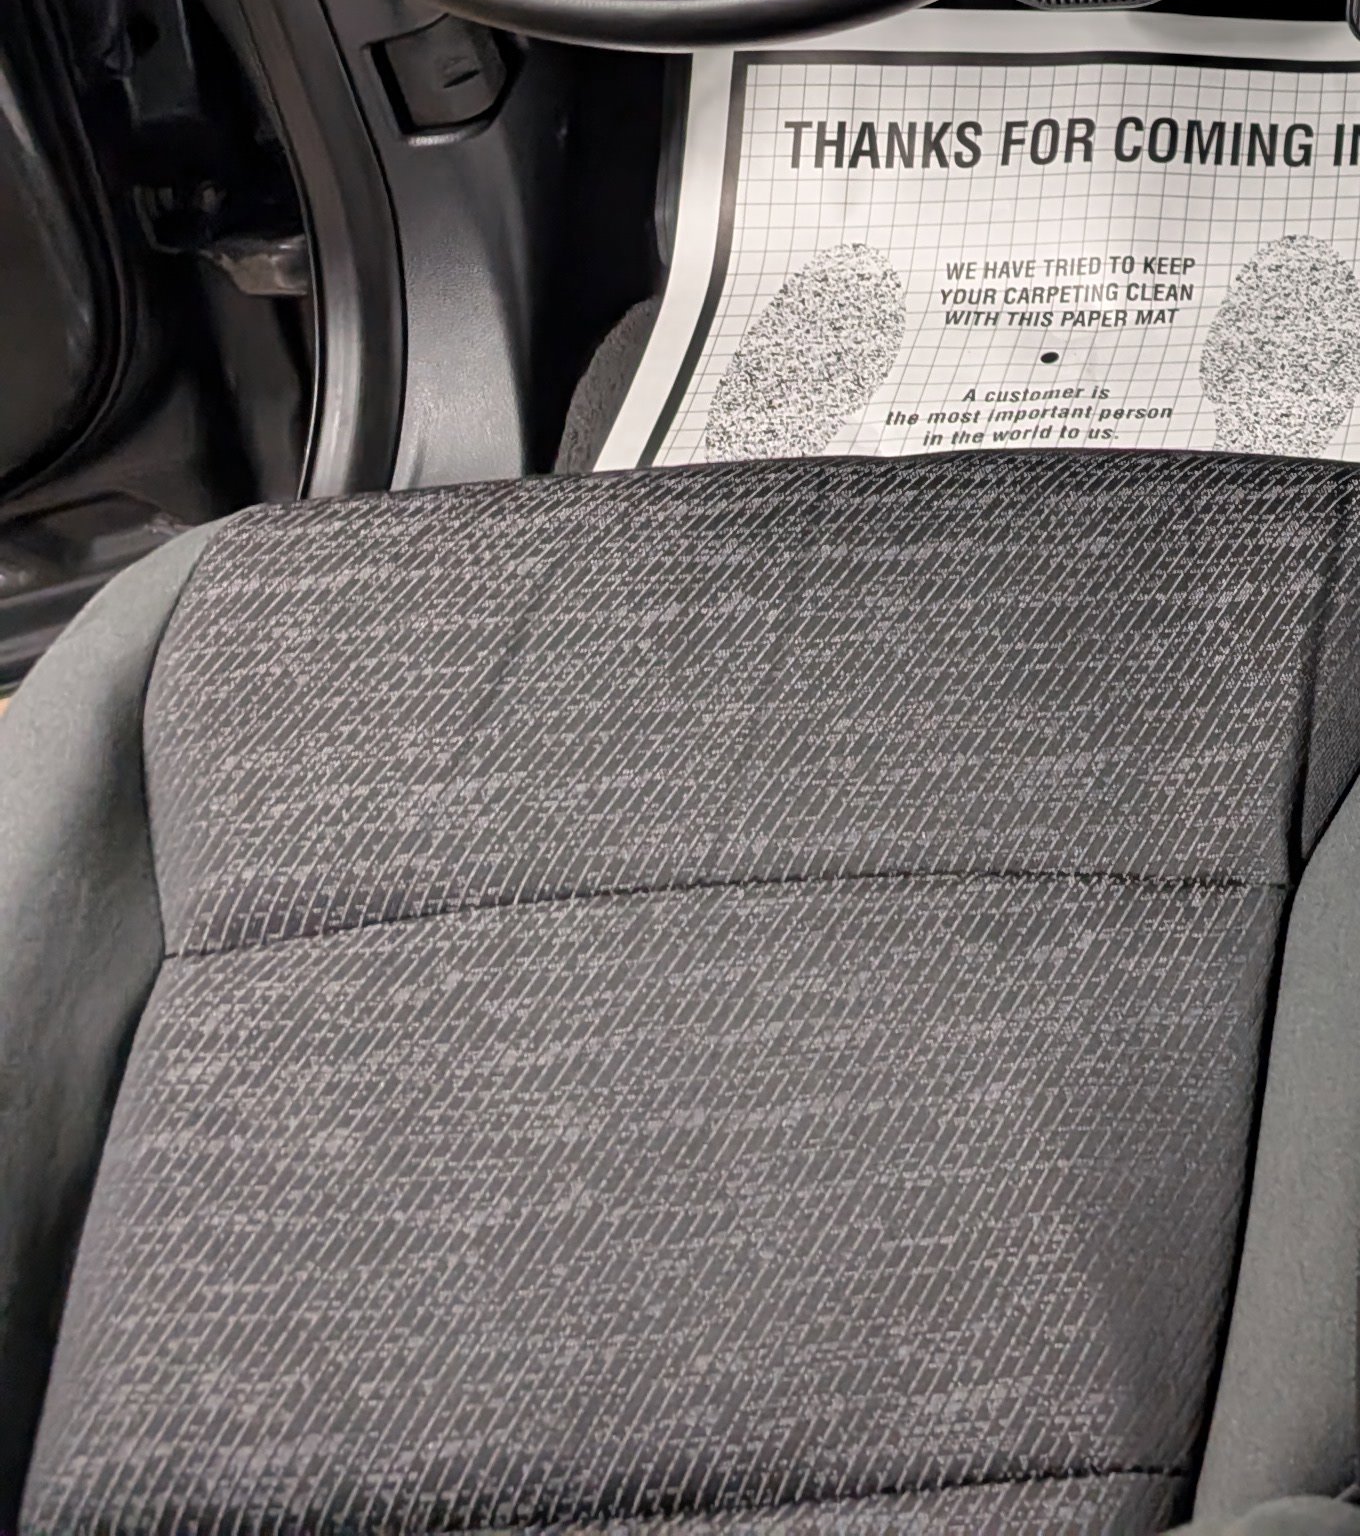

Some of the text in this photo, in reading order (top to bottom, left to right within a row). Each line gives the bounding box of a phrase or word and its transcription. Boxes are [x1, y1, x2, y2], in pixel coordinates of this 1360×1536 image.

[784, 120, 982, 170] THANKS
[1000, 118, 1095, 167] FOR
[1113, 117, 1314, 167] COMING
[946, 256, 1196, 280] WE HAVE TRIED TO KEEP
[941, 282, 1194, 305] YOUR CARPETING CLEAN
[945, 308, 1179, 327] WITH THIS PAPER MAT
[962, 385, 1110, 402] A customer is
[885, 406, 1173, 426] the most important person
[923, 425, 1120, 446] in the world to us.
